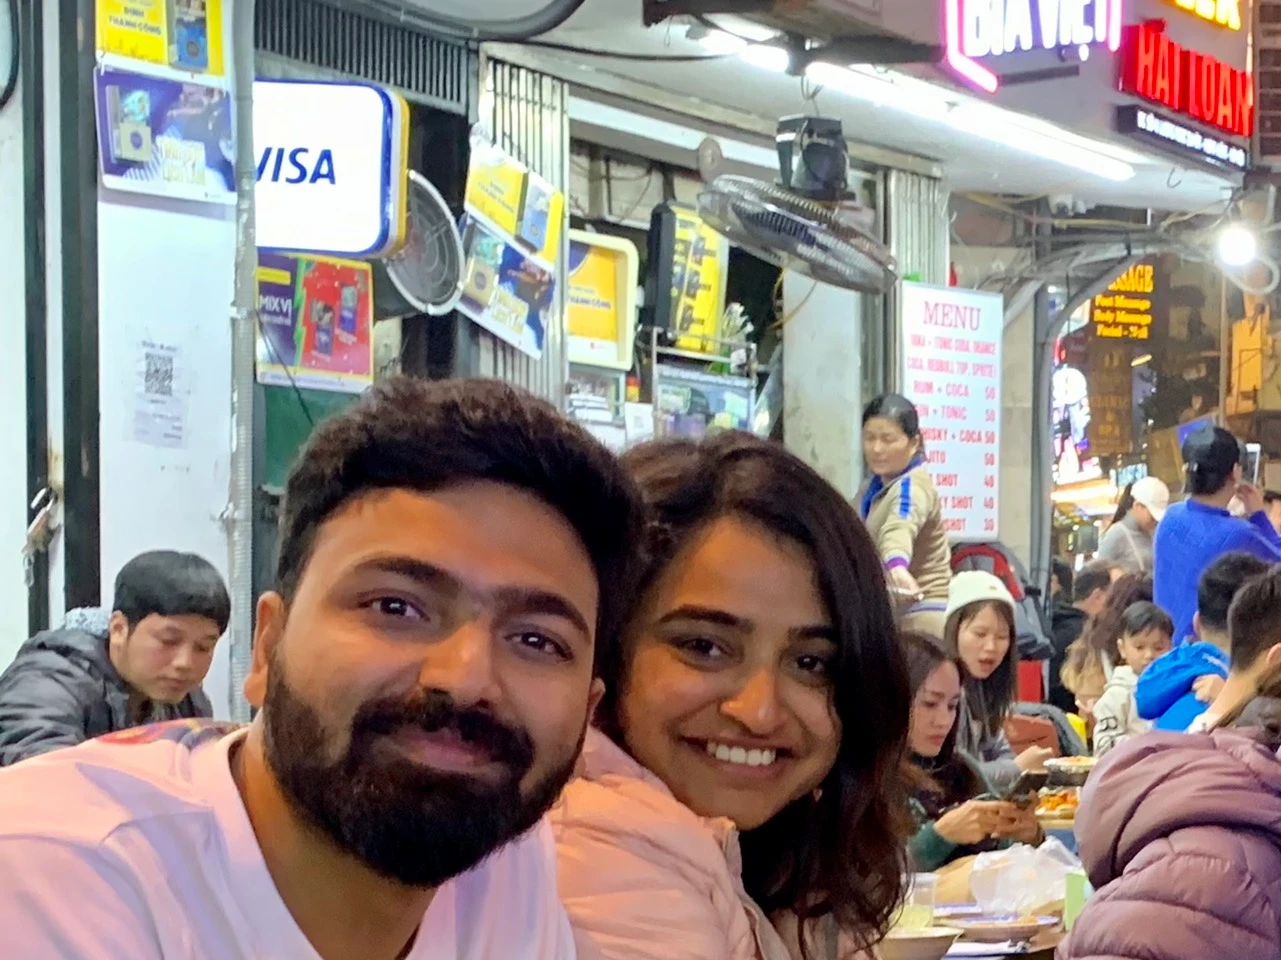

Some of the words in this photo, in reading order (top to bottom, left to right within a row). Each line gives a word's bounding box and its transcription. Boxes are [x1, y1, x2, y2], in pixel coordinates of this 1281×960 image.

[923, 300, 982, 331] MENU
[946, 383, 969, 397] COCA
[942, 405, 968, 420] TONIC
[985, 408, 996, 422] 50
[960, 430, 982, 444] COCA
[985, 430, 996, 445] 50
[926, 450, 947, 464] JITO
[984, 452, 995, 466] 50
[936, 473, 959, 487] SHOT
[984, 474, 995, 488] 40
[951, 496, 974, 509] SHOT
[984, 496, 995, 509] 40
